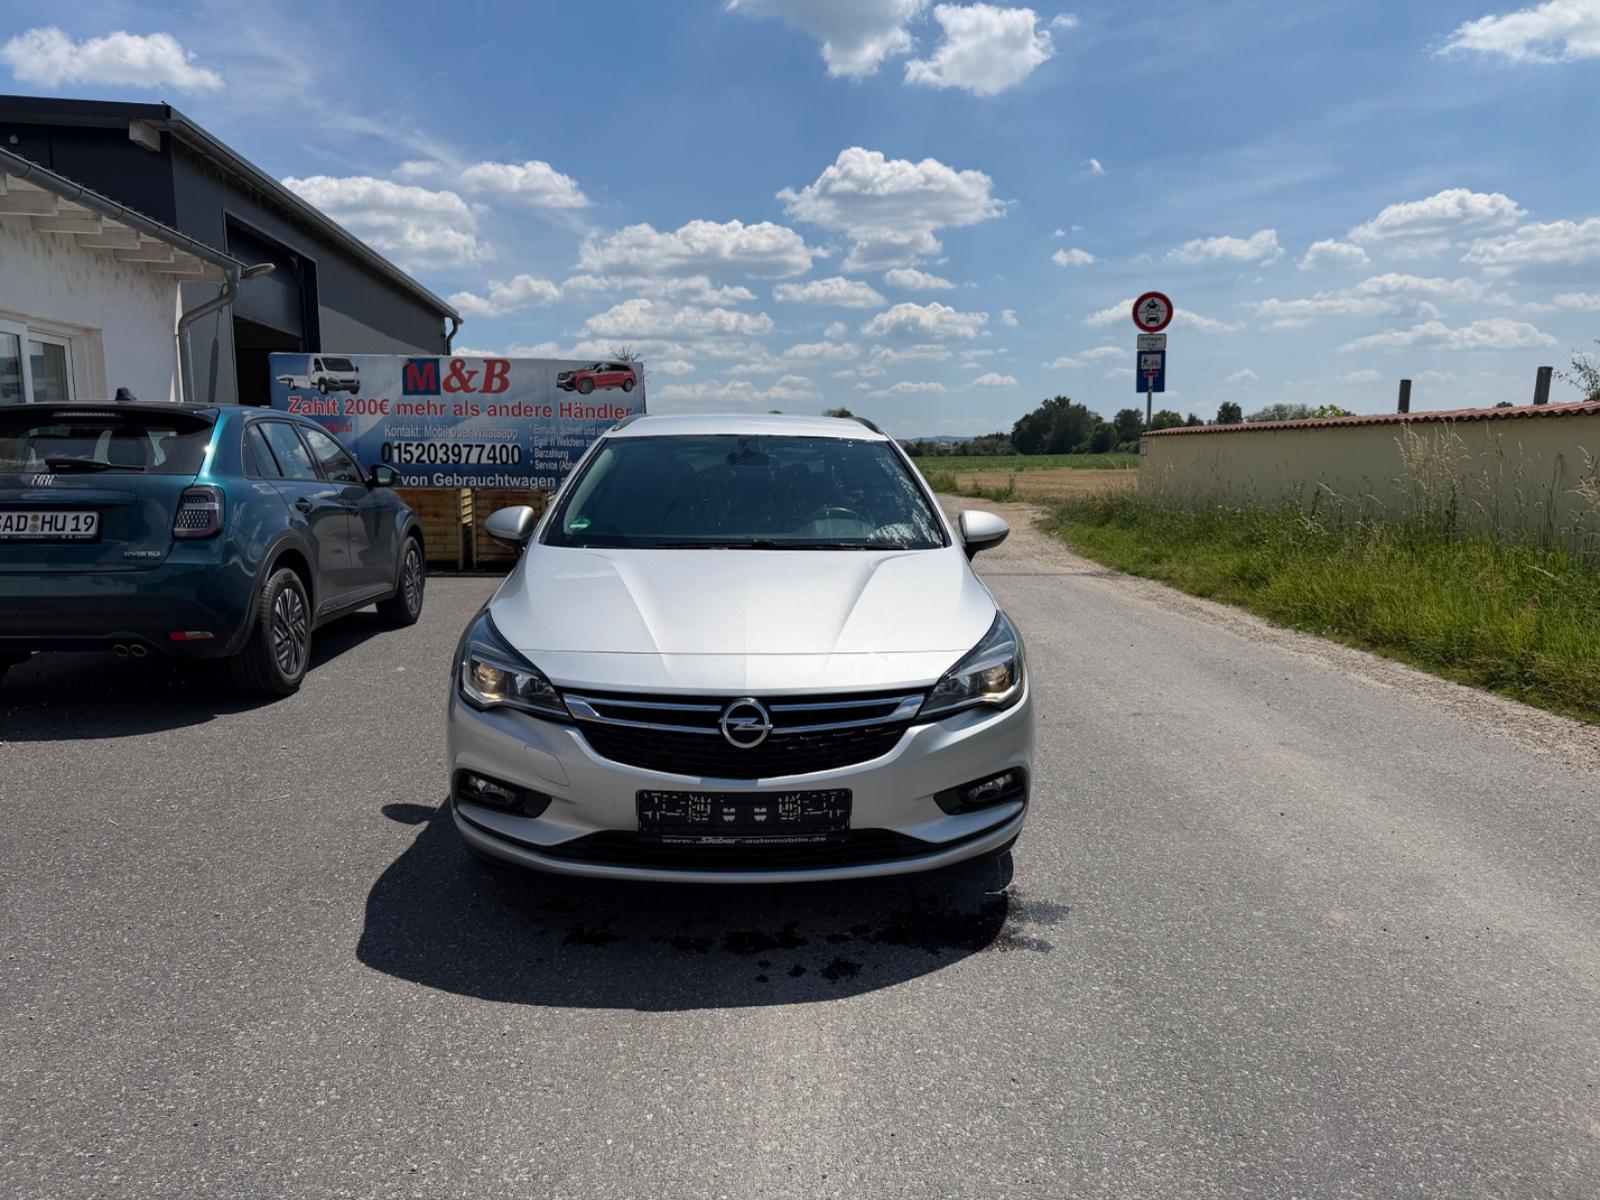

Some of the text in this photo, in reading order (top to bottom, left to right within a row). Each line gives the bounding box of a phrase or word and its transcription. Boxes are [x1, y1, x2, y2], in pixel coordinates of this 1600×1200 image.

[288, 396, 632, 420] Zahlt 200€ mehr als andere Händler
[381, 441, 522, 464] 015203977400
[31, 474, 57, 486] FIAT
[401, 475, 428, 486] von
[433, 473, 556, 489] Gebrauchtwagen
[0, 514, 95, 532] AD HU 19
